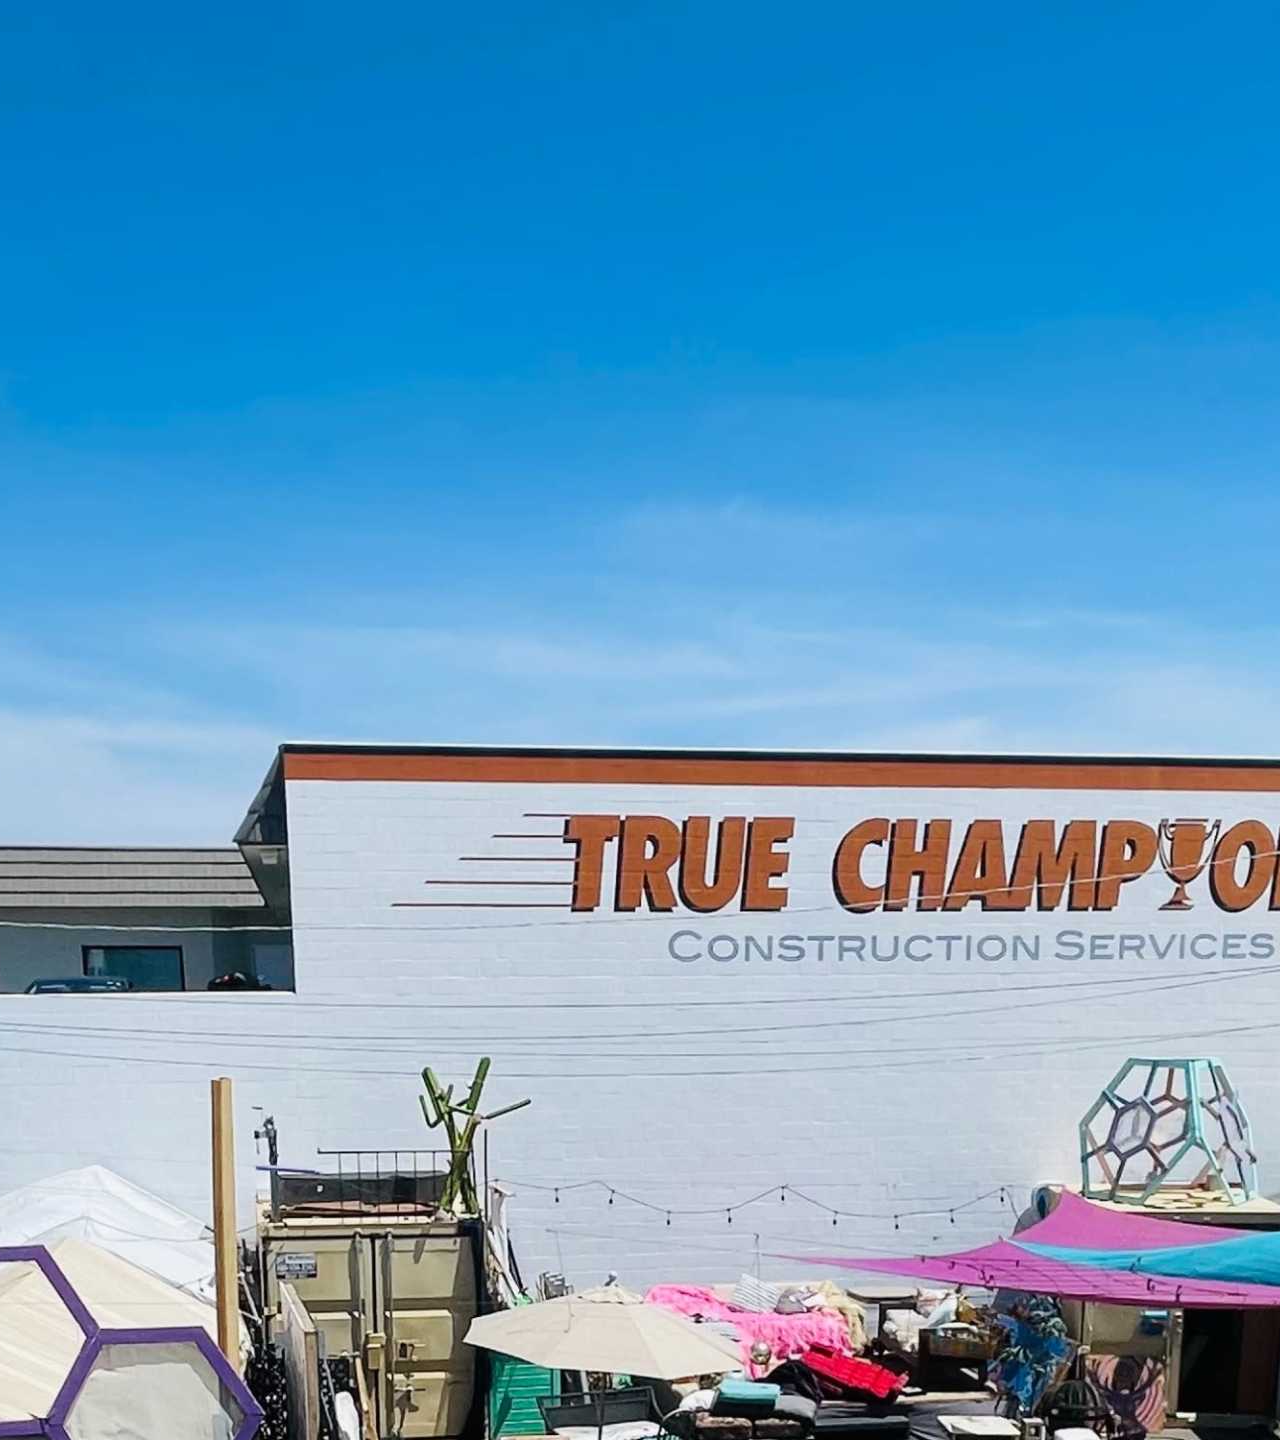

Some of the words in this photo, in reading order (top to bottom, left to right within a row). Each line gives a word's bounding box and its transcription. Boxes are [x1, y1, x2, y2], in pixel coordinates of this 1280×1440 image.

[563, 814, 796, 914] TRUE
[668, 929, 1040, 963] CONSTRUCTION
[1054, 929, 1276, 961] SERVICES
